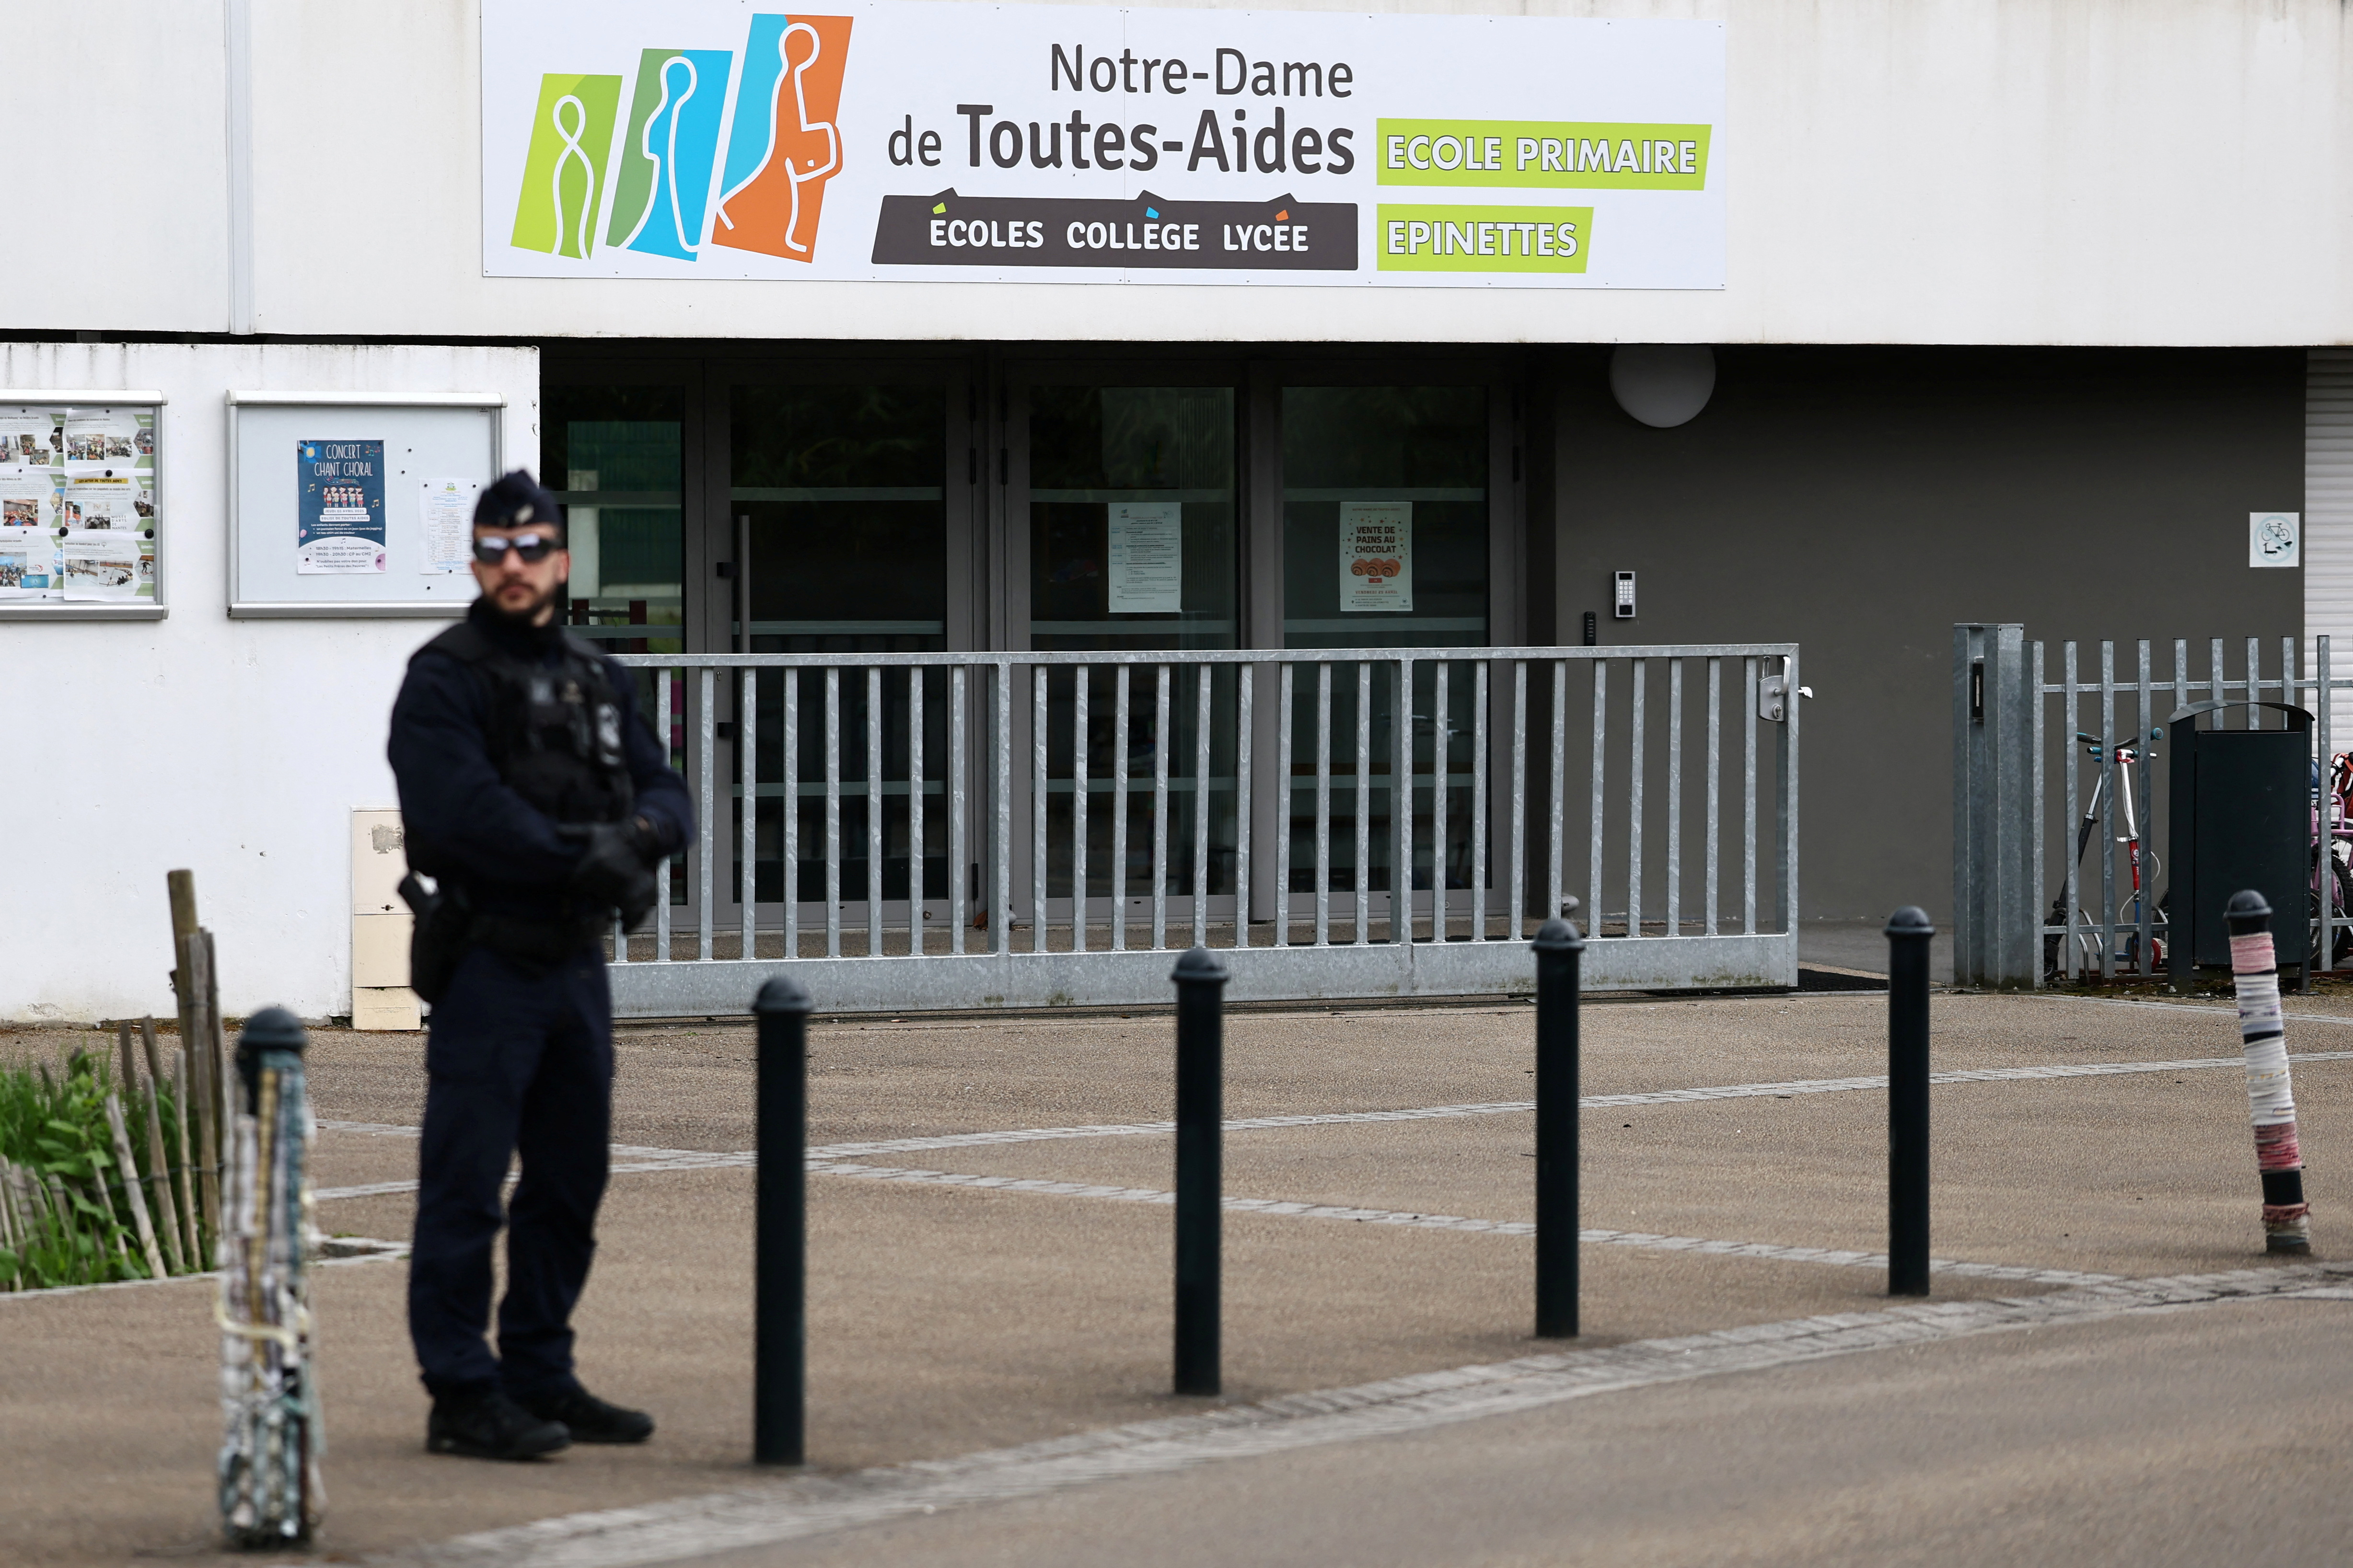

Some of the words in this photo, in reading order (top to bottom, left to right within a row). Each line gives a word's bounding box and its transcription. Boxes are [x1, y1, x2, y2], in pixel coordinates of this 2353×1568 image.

[1052, 44, 1353, 98] Notre-Dame
[888, 114, 942, 167] de
[957, 104, 1355, 175] Toutes-Aides
[1387, 135, 1502, 171] ECOLE
[1516, 137, 1696, 174] PRIMAIRE
[1387, 220, 1578, 257] EPINETTES
[314, 462, 340, 476] CHANT
[344, 462, 373, 476] CHORAL
[326, 444, 361, 459] CONCERT
